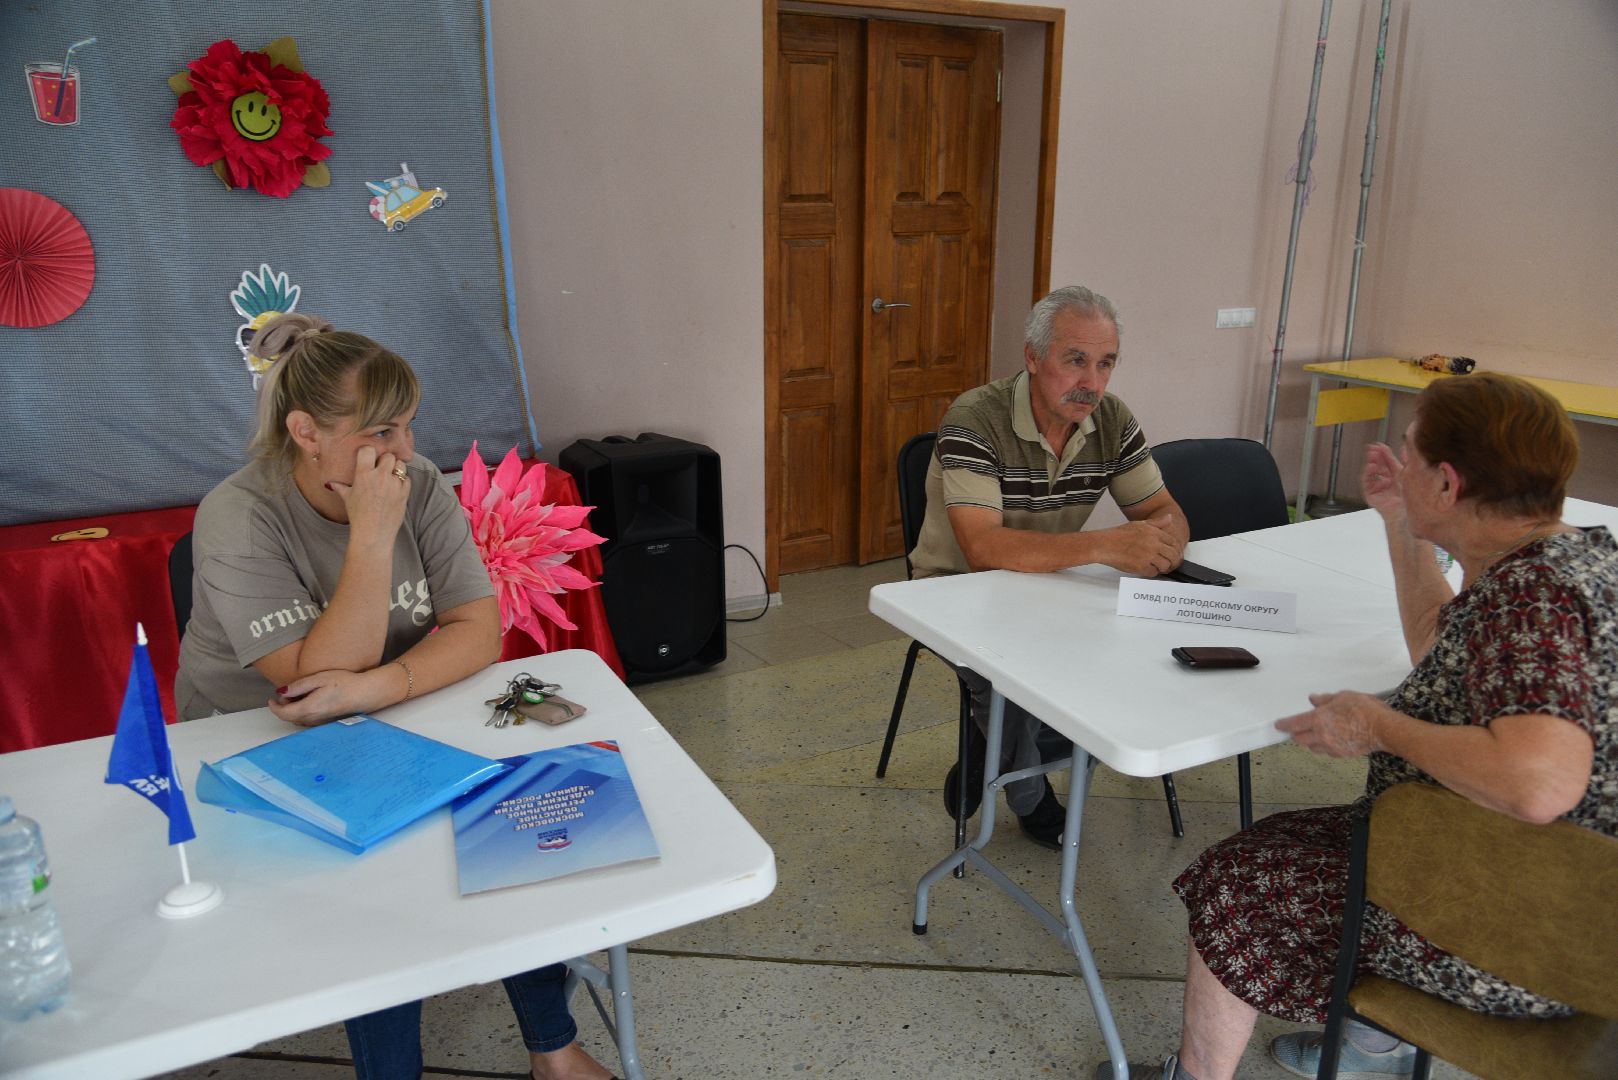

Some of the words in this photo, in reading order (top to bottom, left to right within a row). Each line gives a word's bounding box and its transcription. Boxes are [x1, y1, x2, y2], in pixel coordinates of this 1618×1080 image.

[1133, 592, 1161, 604] ОМВД
[1164, 595, 1177, 604] ПО
[1179, 597, 1242, 611] ГОРОДСКОМУ
[1244, 604, 1279, 615] ОКРУГУ
[1176, 609, 1232, 622] ЛОТОШИНО
[537, 789, 595, 806] ОТДЕЛЕНИЕ
[494, 802, 534, 815] ПАРТИИ
[507, 798, 586, 819] РЕГИОНАЛЬНОЕ
[518, 806, 578, 823] ОБЛАСТНОЕ
[514, 812, 584, 831] МОСКОВСКОЕ
